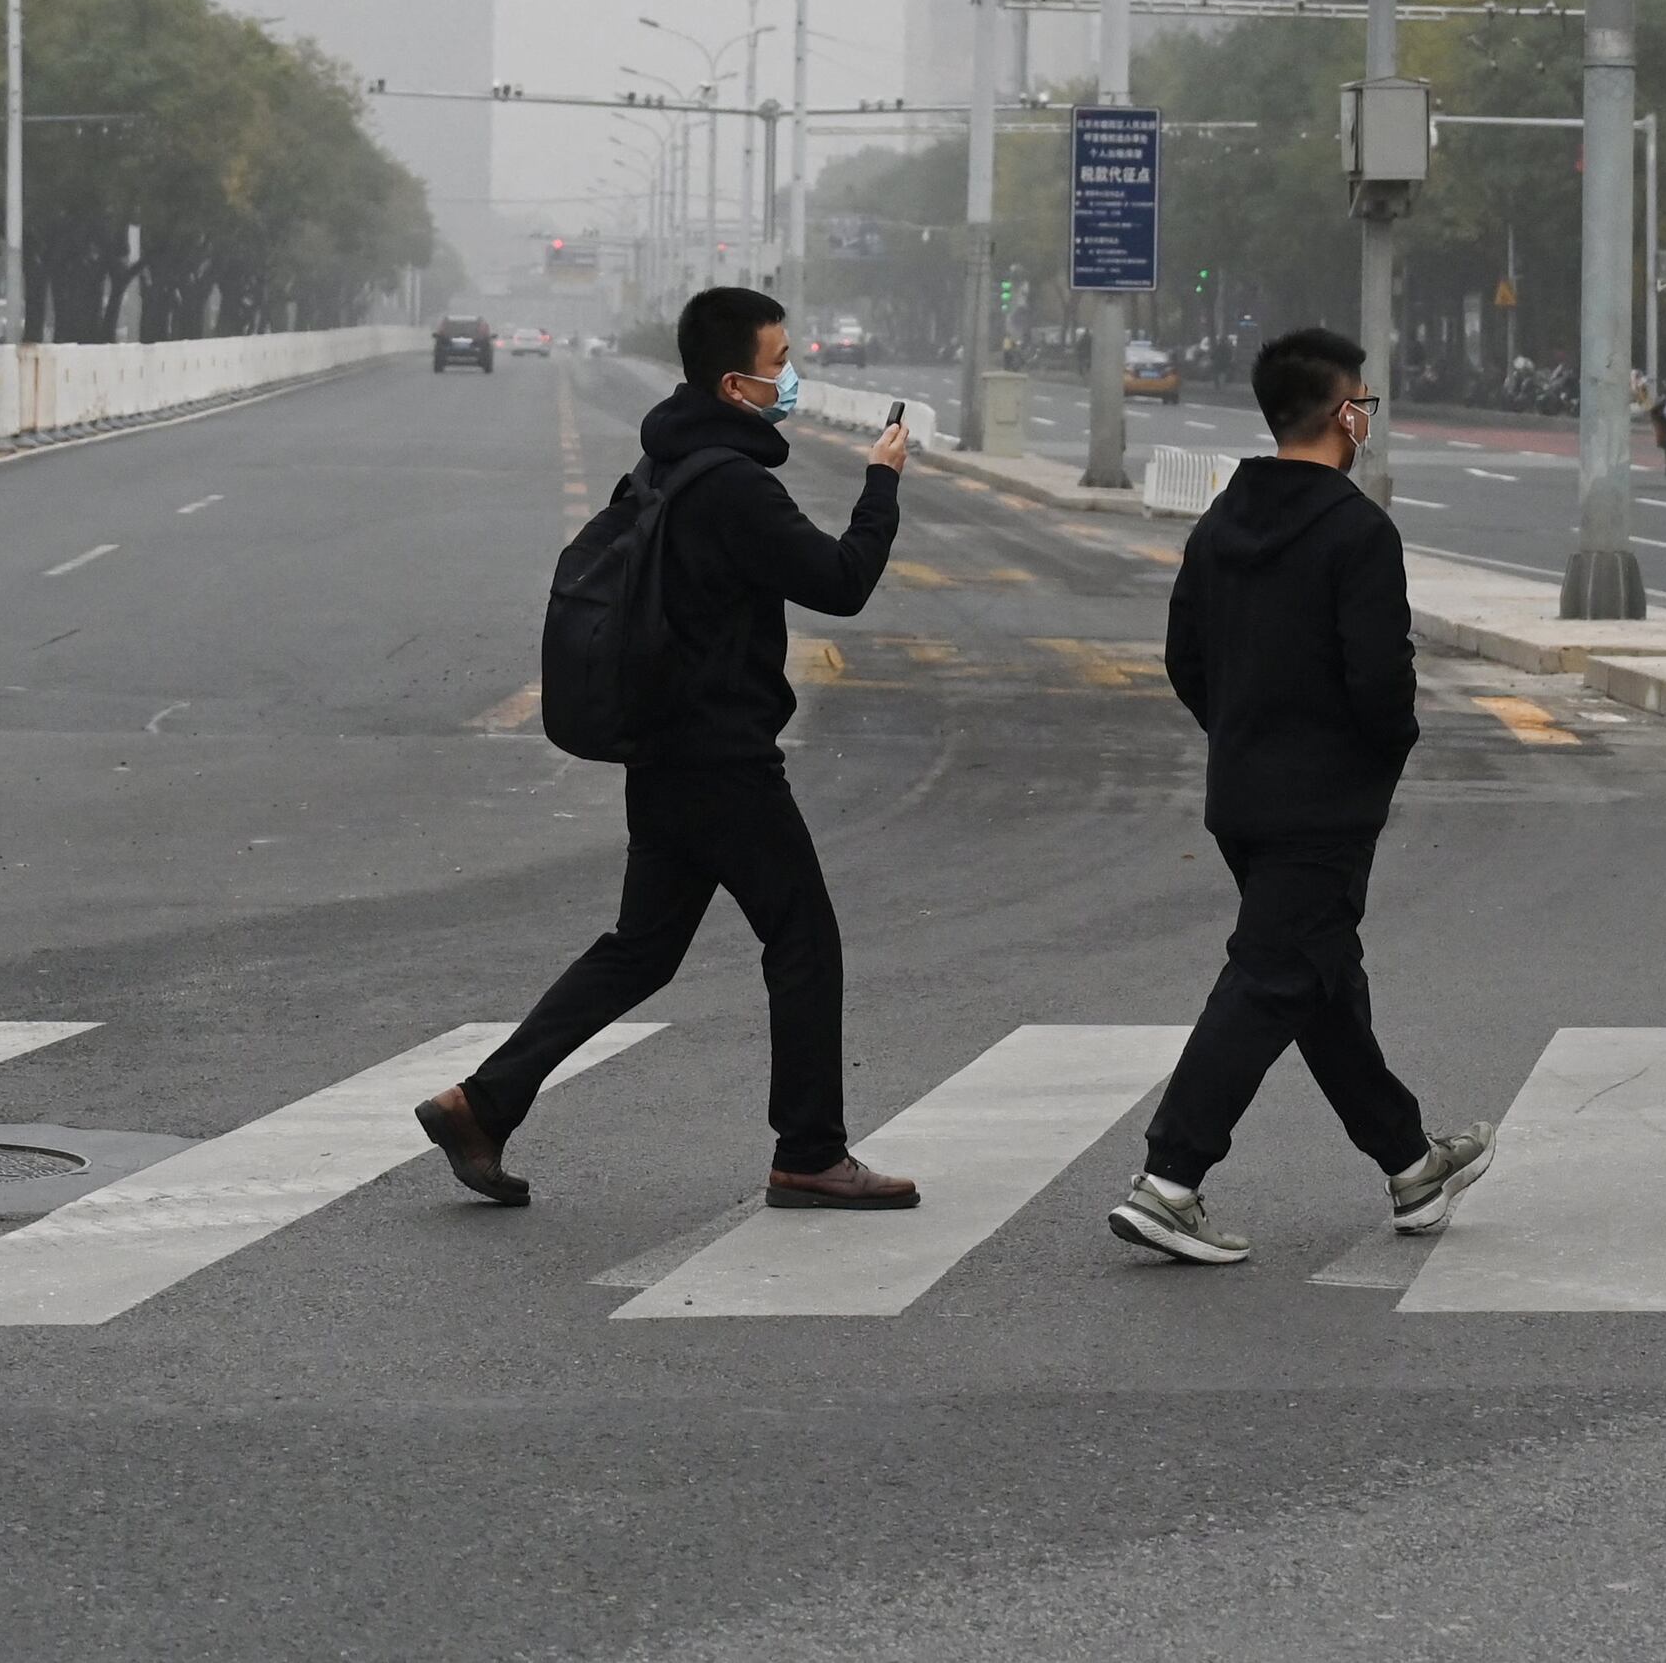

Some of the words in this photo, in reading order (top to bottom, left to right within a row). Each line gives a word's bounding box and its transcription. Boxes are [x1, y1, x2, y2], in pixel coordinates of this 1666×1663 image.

[1080, 166, 1150, 184] 税款代征点
